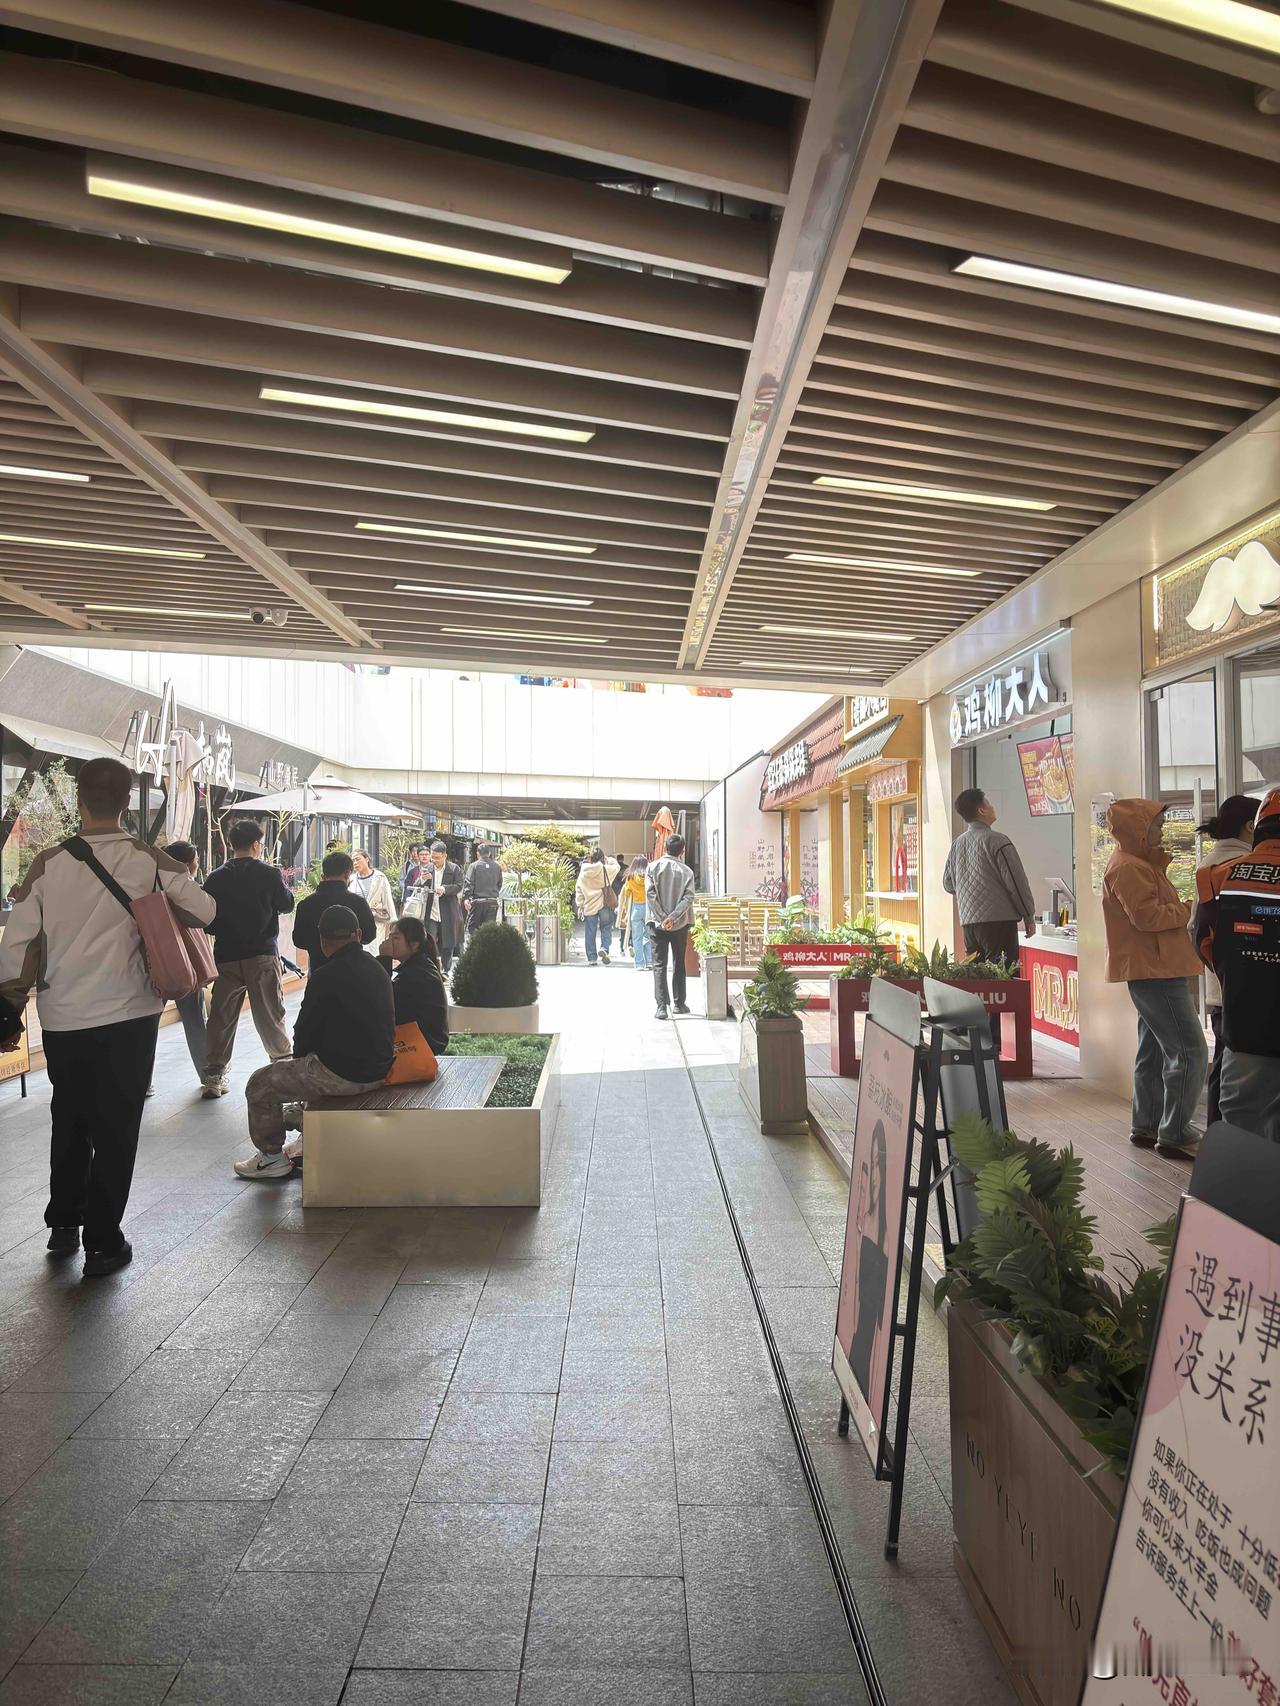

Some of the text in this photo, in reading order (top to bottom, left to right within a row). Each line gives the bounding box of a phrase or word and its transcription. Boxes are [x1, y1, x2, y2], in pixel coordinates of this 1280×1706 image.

[964, 652, 1048, 736] 鸡柳大人
[783, 951, 827, 962] 鸡柳大人
[1186, 1251, 1280, 1364] 遇到事
[1175, 1323, 1272, 1446] 没关系
[966, 1432, 985, 1479] NO
[1053, 1567, 1081, 1632] NO
[1147, 1466, 1273, 1622] 没有收入 吃饭也成问题
[1153, 1436, 1280, 1602] 如果你正在处于 十分低
